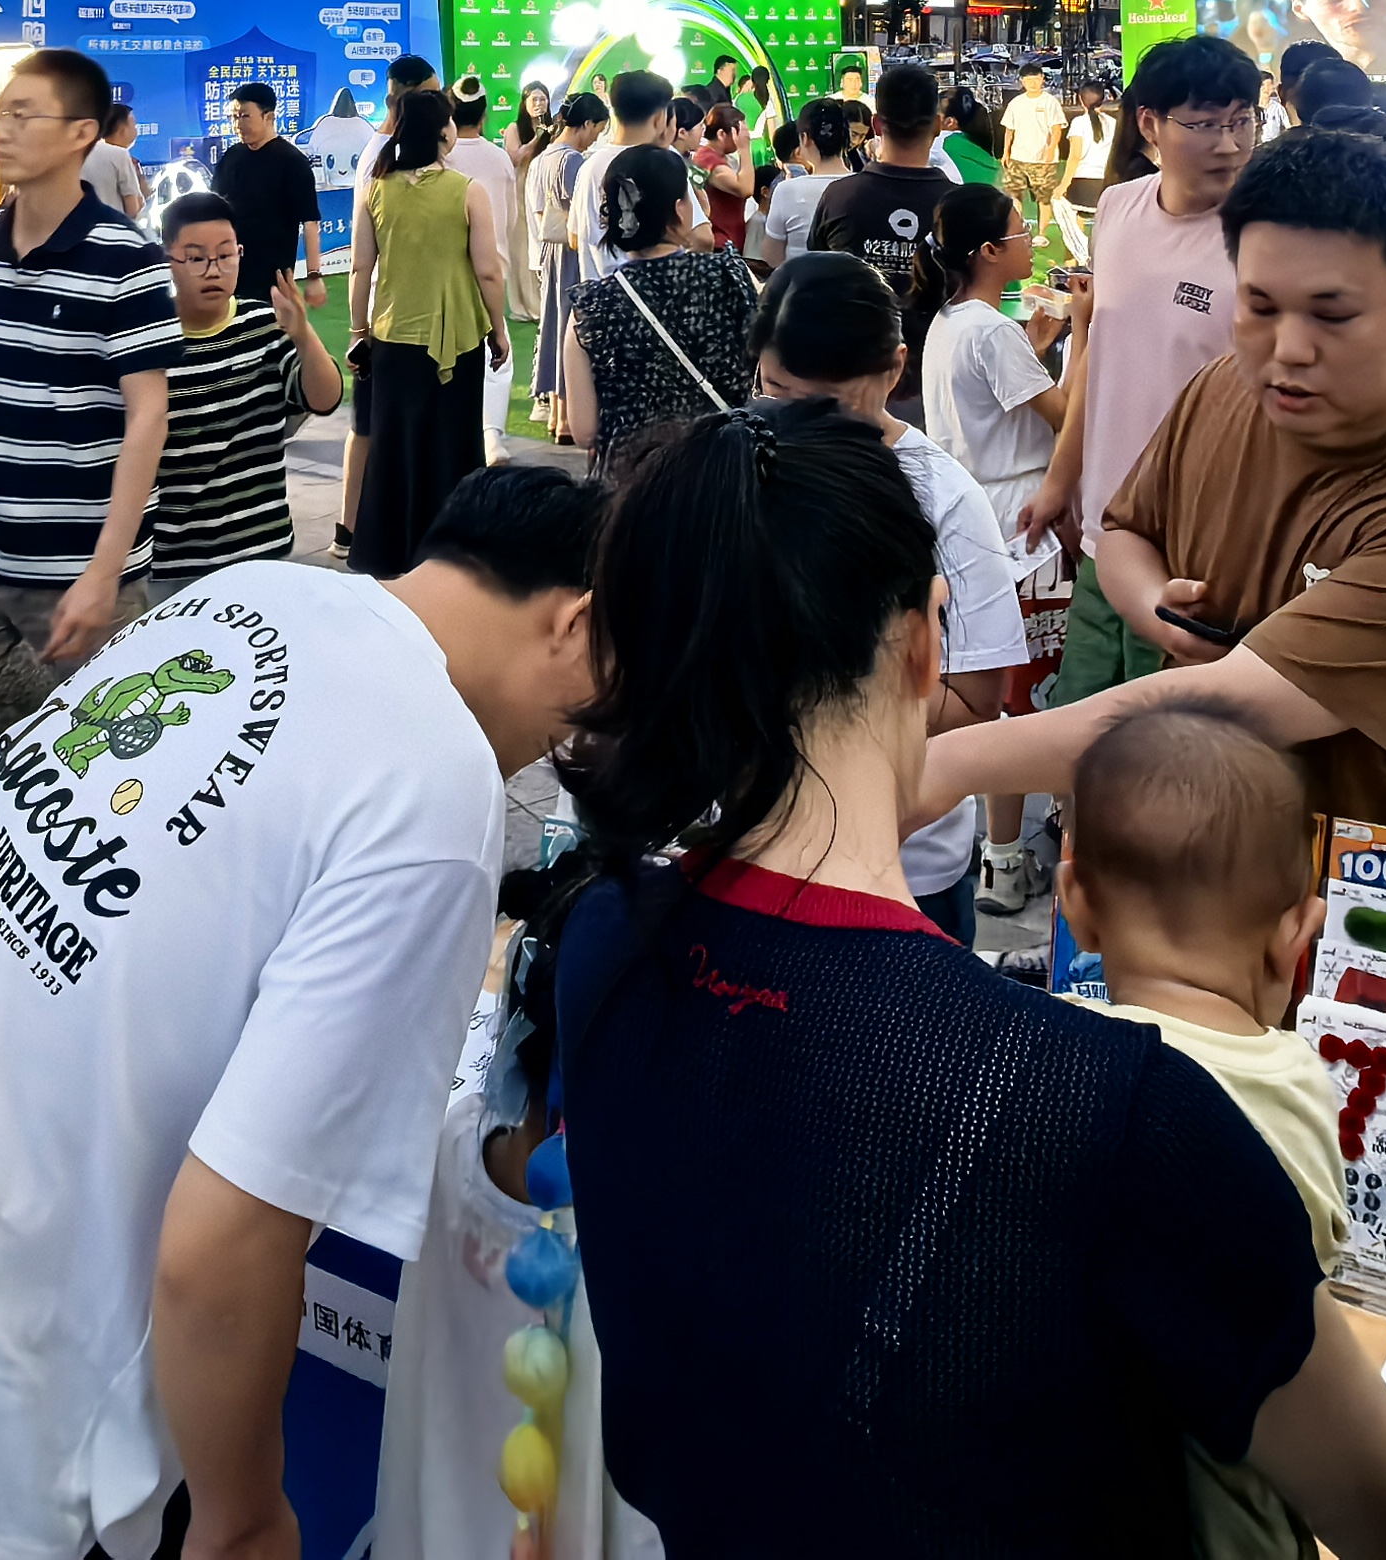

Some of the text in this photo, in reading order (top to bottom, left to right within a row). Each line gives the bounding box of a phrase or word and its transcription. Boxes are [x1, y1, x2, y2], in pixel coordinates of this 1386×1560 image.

[1128, 11, 1188, 24] Heineken
[208, 65, 254, 79] 全民反诈
[166, 602, 290, 847] SPORTSWEAR
[29, 960, 63, 997] 1933
[303, 1302, 393, 1362] 国体育
